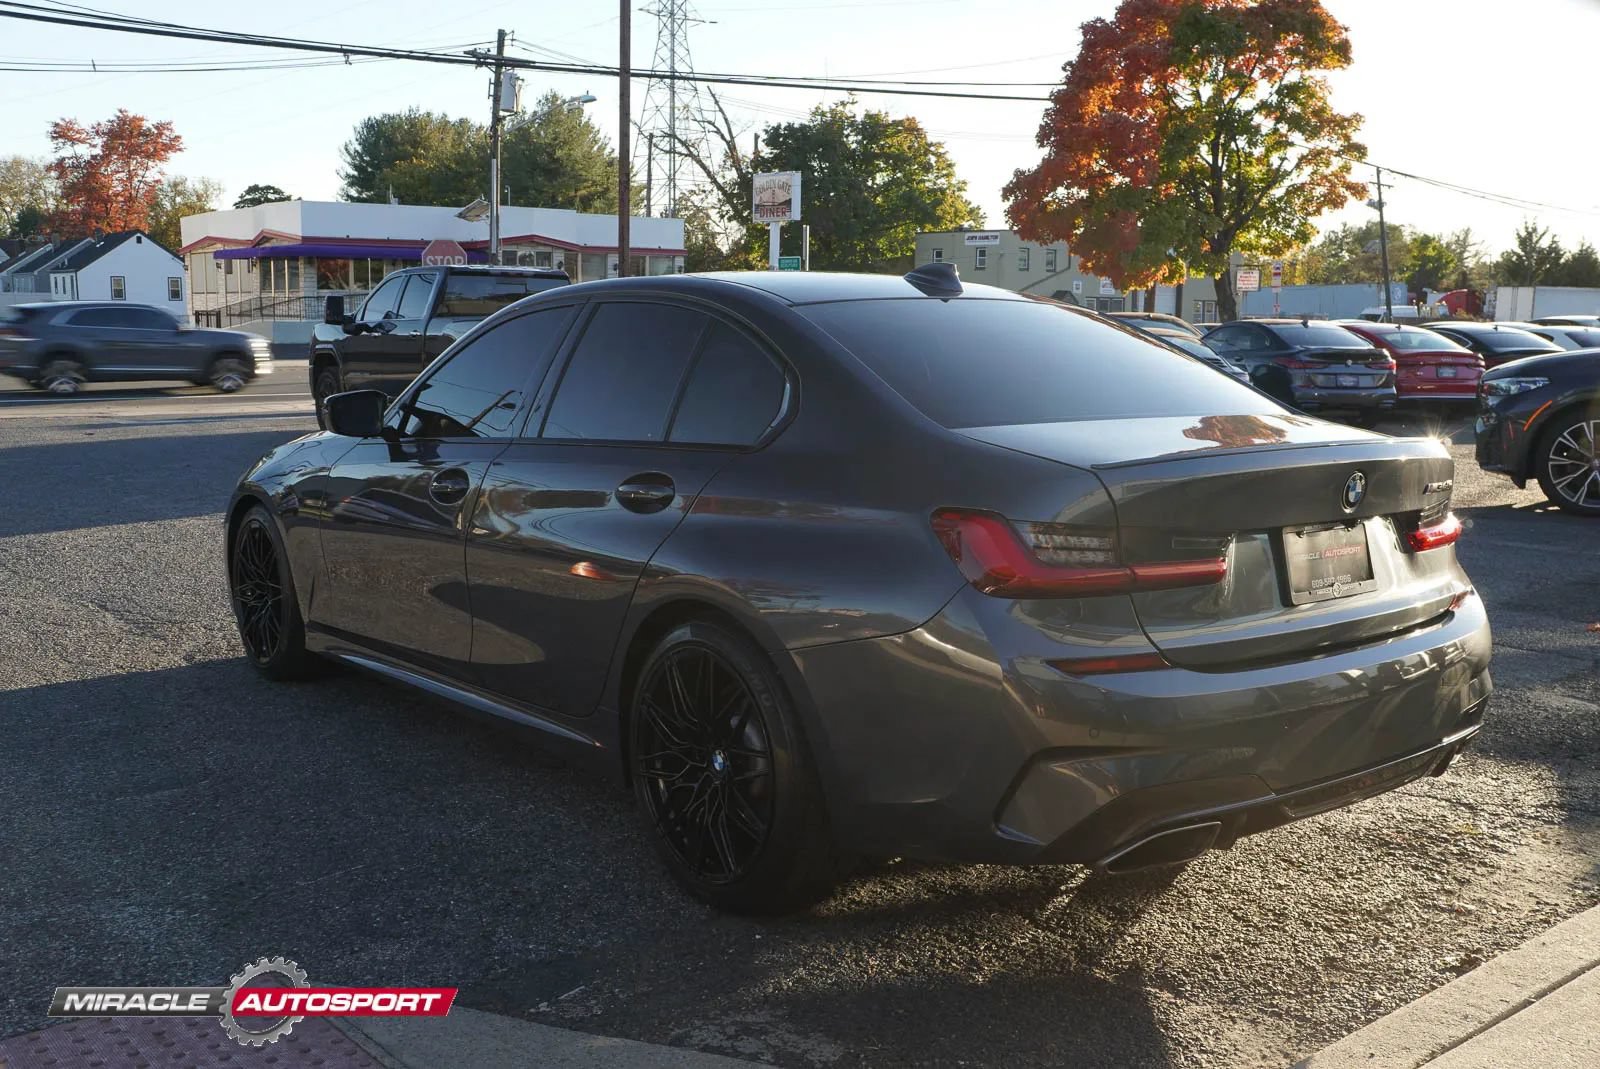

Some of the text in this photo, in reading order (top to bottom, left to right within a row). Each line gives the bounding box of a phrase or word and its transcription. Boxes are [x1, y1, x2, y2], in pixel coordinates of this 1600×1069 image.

[755, 179, 792, 196] GOLDEN GATE
[759, 207, 787, 218] DINER
[426, 255, 465, 267] STOP
[1324, 545, 1362, 558] AUTOSPORT
